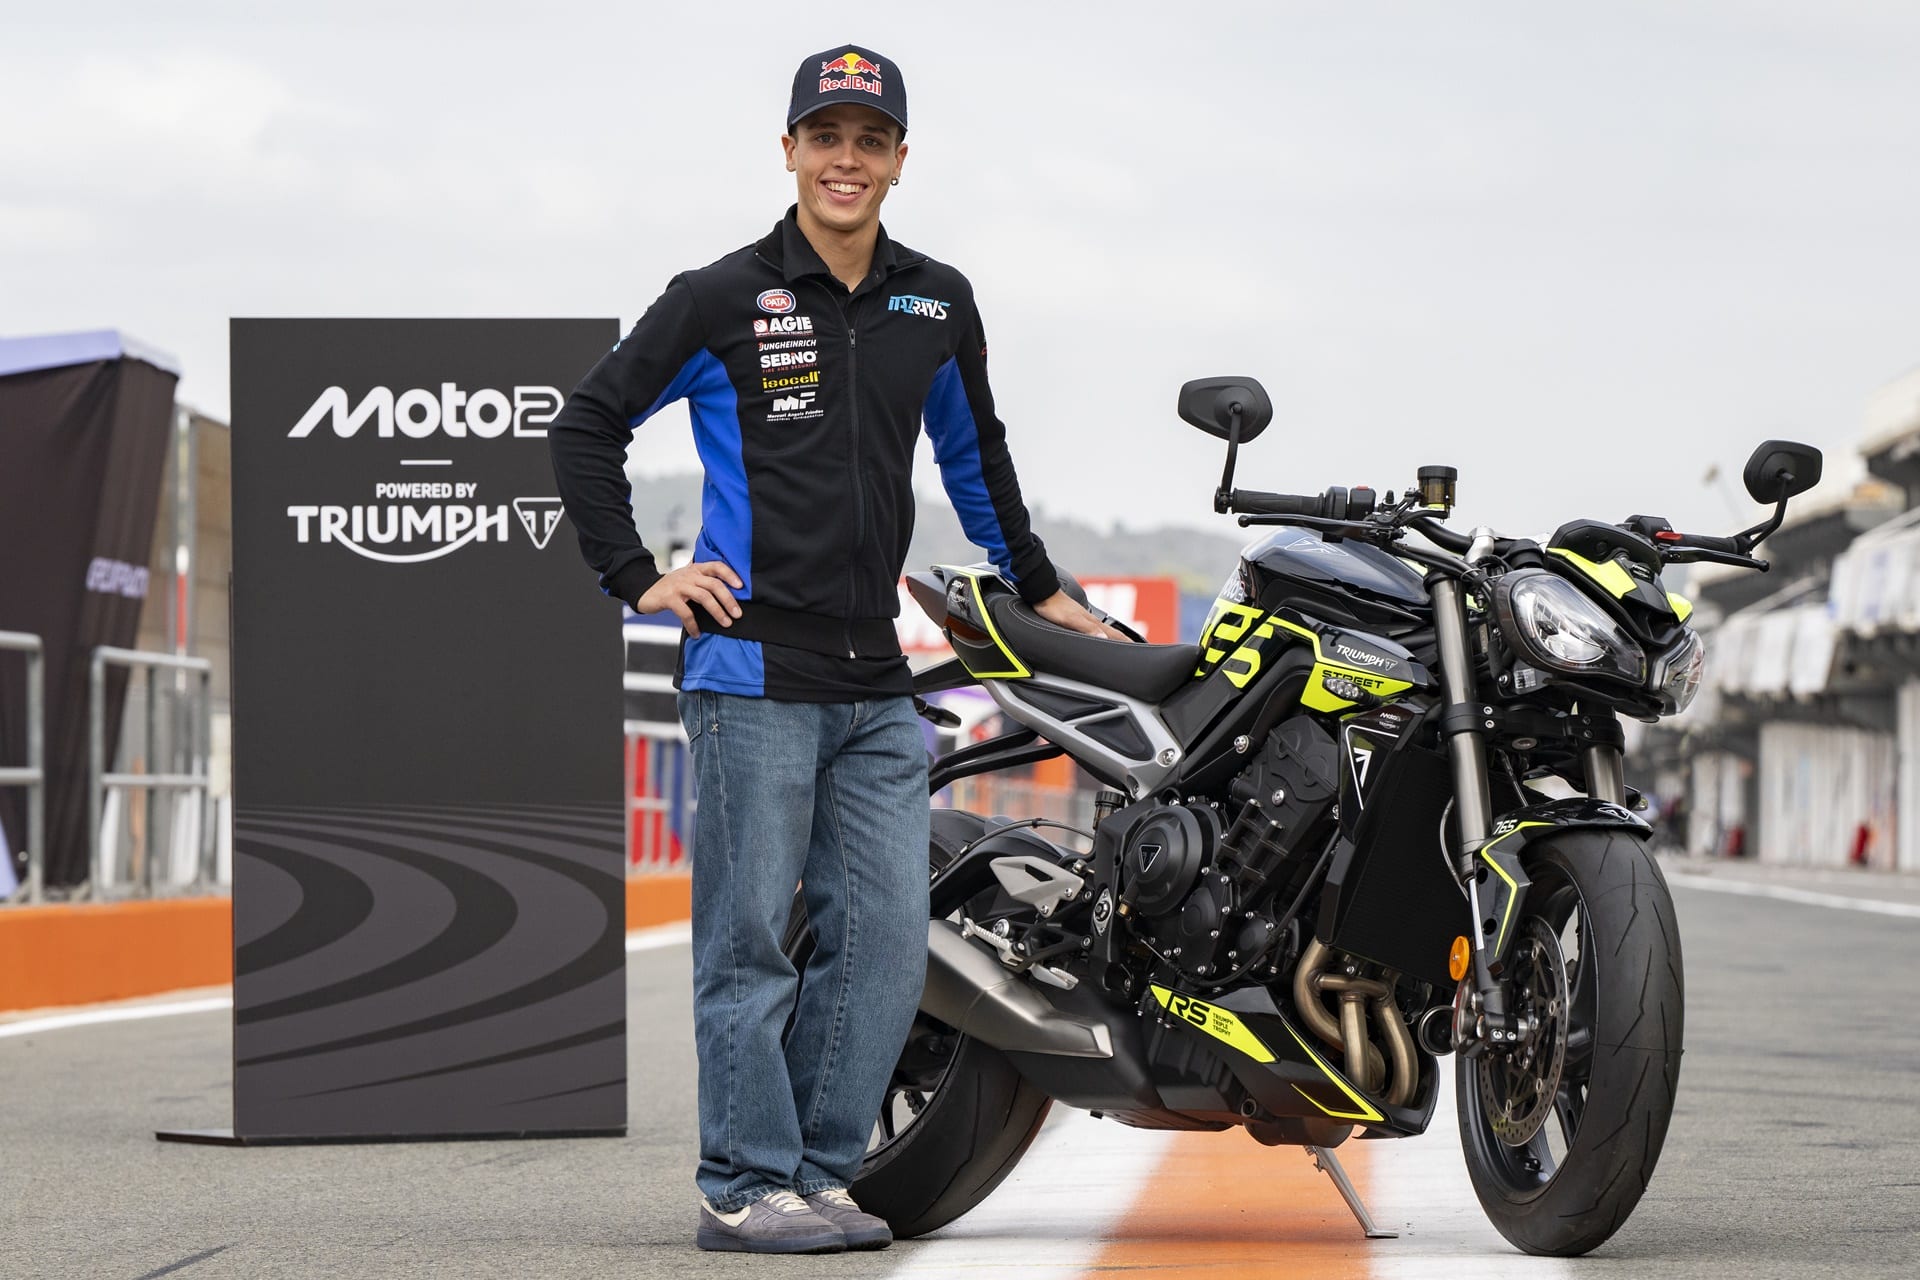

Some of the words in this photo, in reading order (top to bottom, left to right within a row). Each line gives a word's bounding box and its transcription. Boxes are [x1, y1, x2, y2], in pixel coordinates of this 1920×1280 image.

[819, 74, 852, 93] Red
[852, 75, 882, 96] Bull
[765, 297, 788, 307] PATA
[769, 316, 813, 332] AGIE
[759, 339, 817, 351] JUNGHEINRICH
[762, 371, 819, 389] isocell
[287, 382, 565, 438] Moto2
[376, 483, 452, 498] POWERED
[455, 483, 477, 498] BY
[287, 505, 508, 563] TRIUMPH
[1336, 645, 1384, 666] TRIUMPH
[1322, 670, 1384, 688] STREET
[1493, 819, 1518, 835] 765
[1166, 992, 1210, 1026] RS
[1213, 1013, 1233, 1025] TRIUMPH
[1213, 1019, 1228, 1030] TRIPLE
[1213, 1025, 1230, 1036] TROPHY
